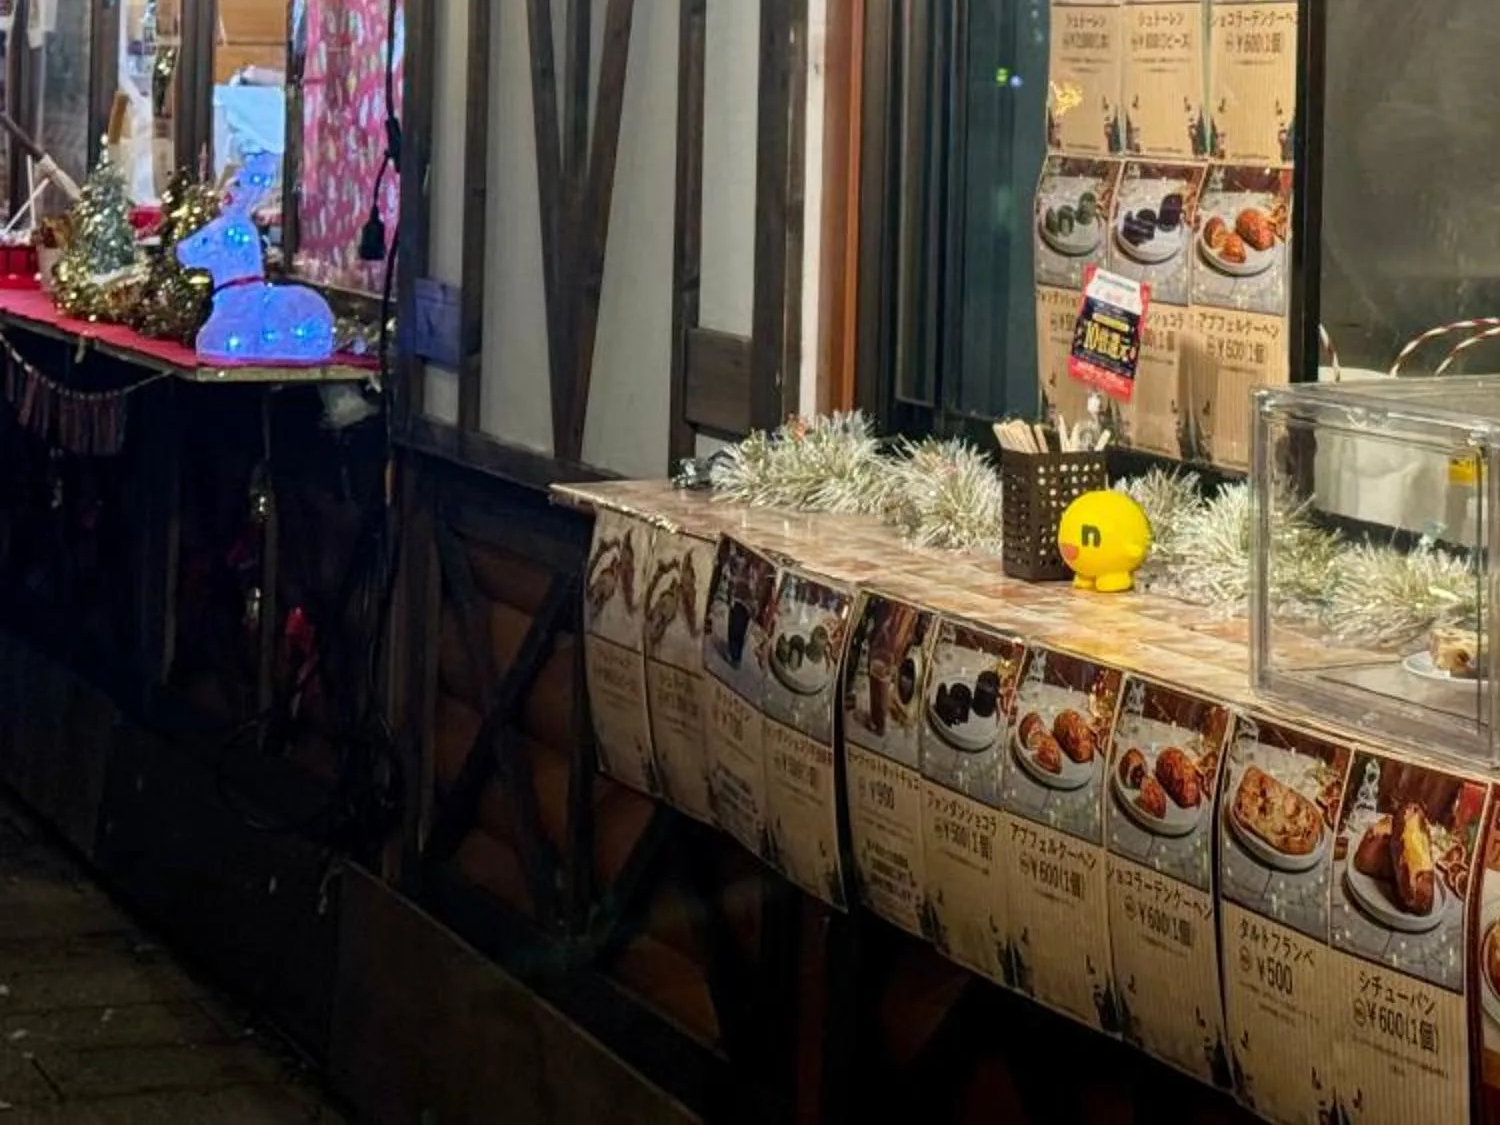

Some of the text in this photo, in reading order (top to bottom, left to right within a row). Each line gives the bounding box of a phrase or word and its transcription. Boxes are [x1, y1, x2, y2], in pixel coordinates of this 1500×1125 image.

[1239, 918, 1315, 967] タルトフランベ
[1359, 970, 1435, 1015] シチューパン
